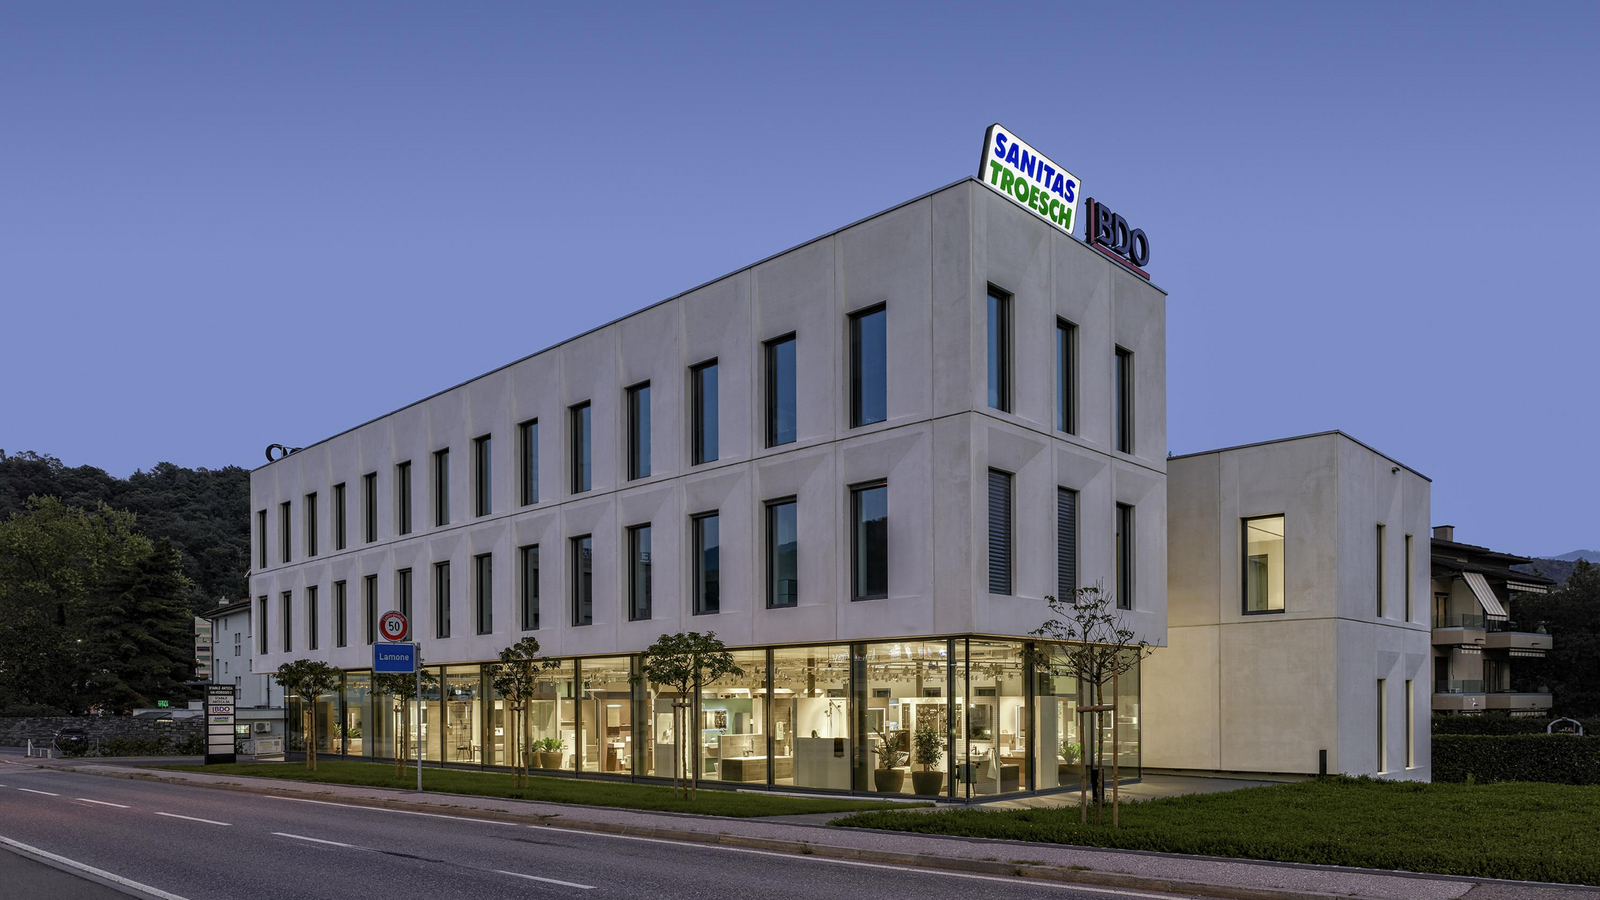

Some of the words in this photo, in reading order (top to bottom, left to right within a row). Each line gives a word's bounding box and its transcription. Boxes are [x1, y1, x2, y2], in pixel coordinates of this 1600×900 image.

[990, 159, 1072, 230] TROESCH
[994, 132, 1076, 204] SANITAS
[1094, 202, 1150, 267] BDO
[379, 652, 410, 661] Lamone
[388, 621, 400, 631] 50
